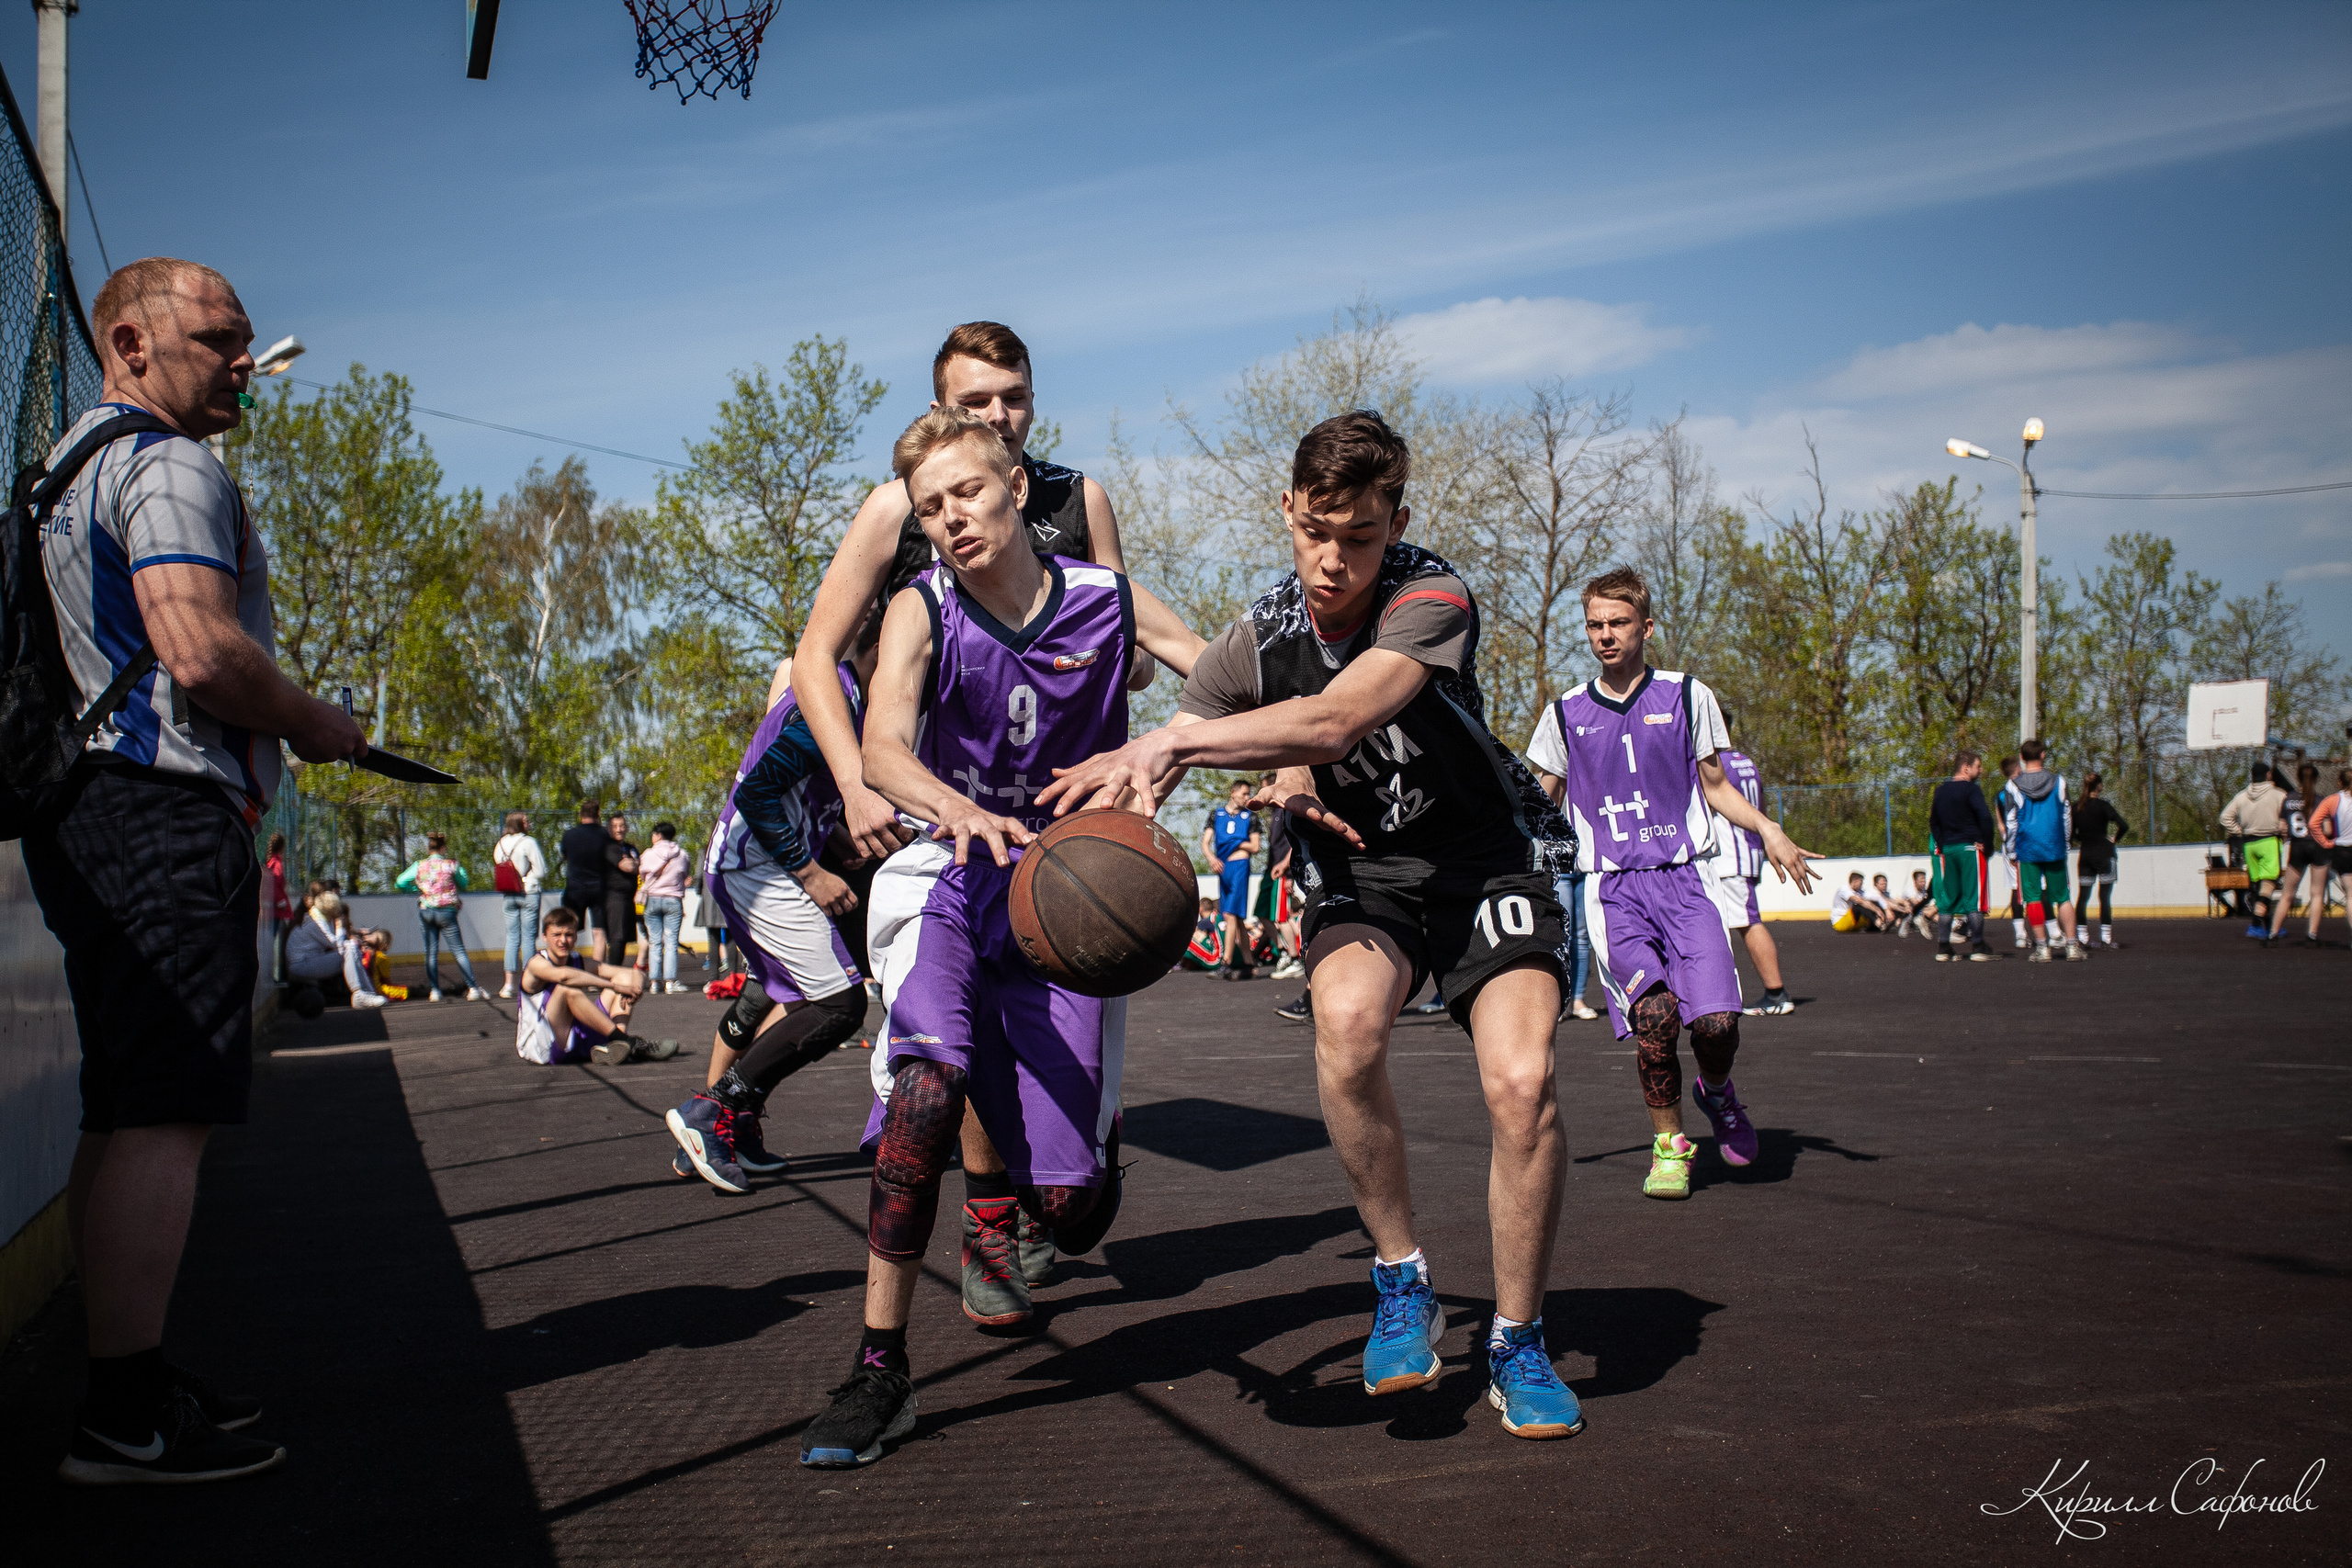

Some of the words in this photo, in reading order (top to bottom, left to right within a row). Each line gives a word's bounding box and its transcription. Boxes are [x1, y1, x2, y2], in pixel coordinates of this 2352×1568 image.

[1008, 684, 1037, 747] 9
[1621, 732, 1638, 773] 1
[1638, 823, 1678, 843] group
[1473, 895, 1534, 950] 10
[978, 1204, 1009, 1221] NIKE
